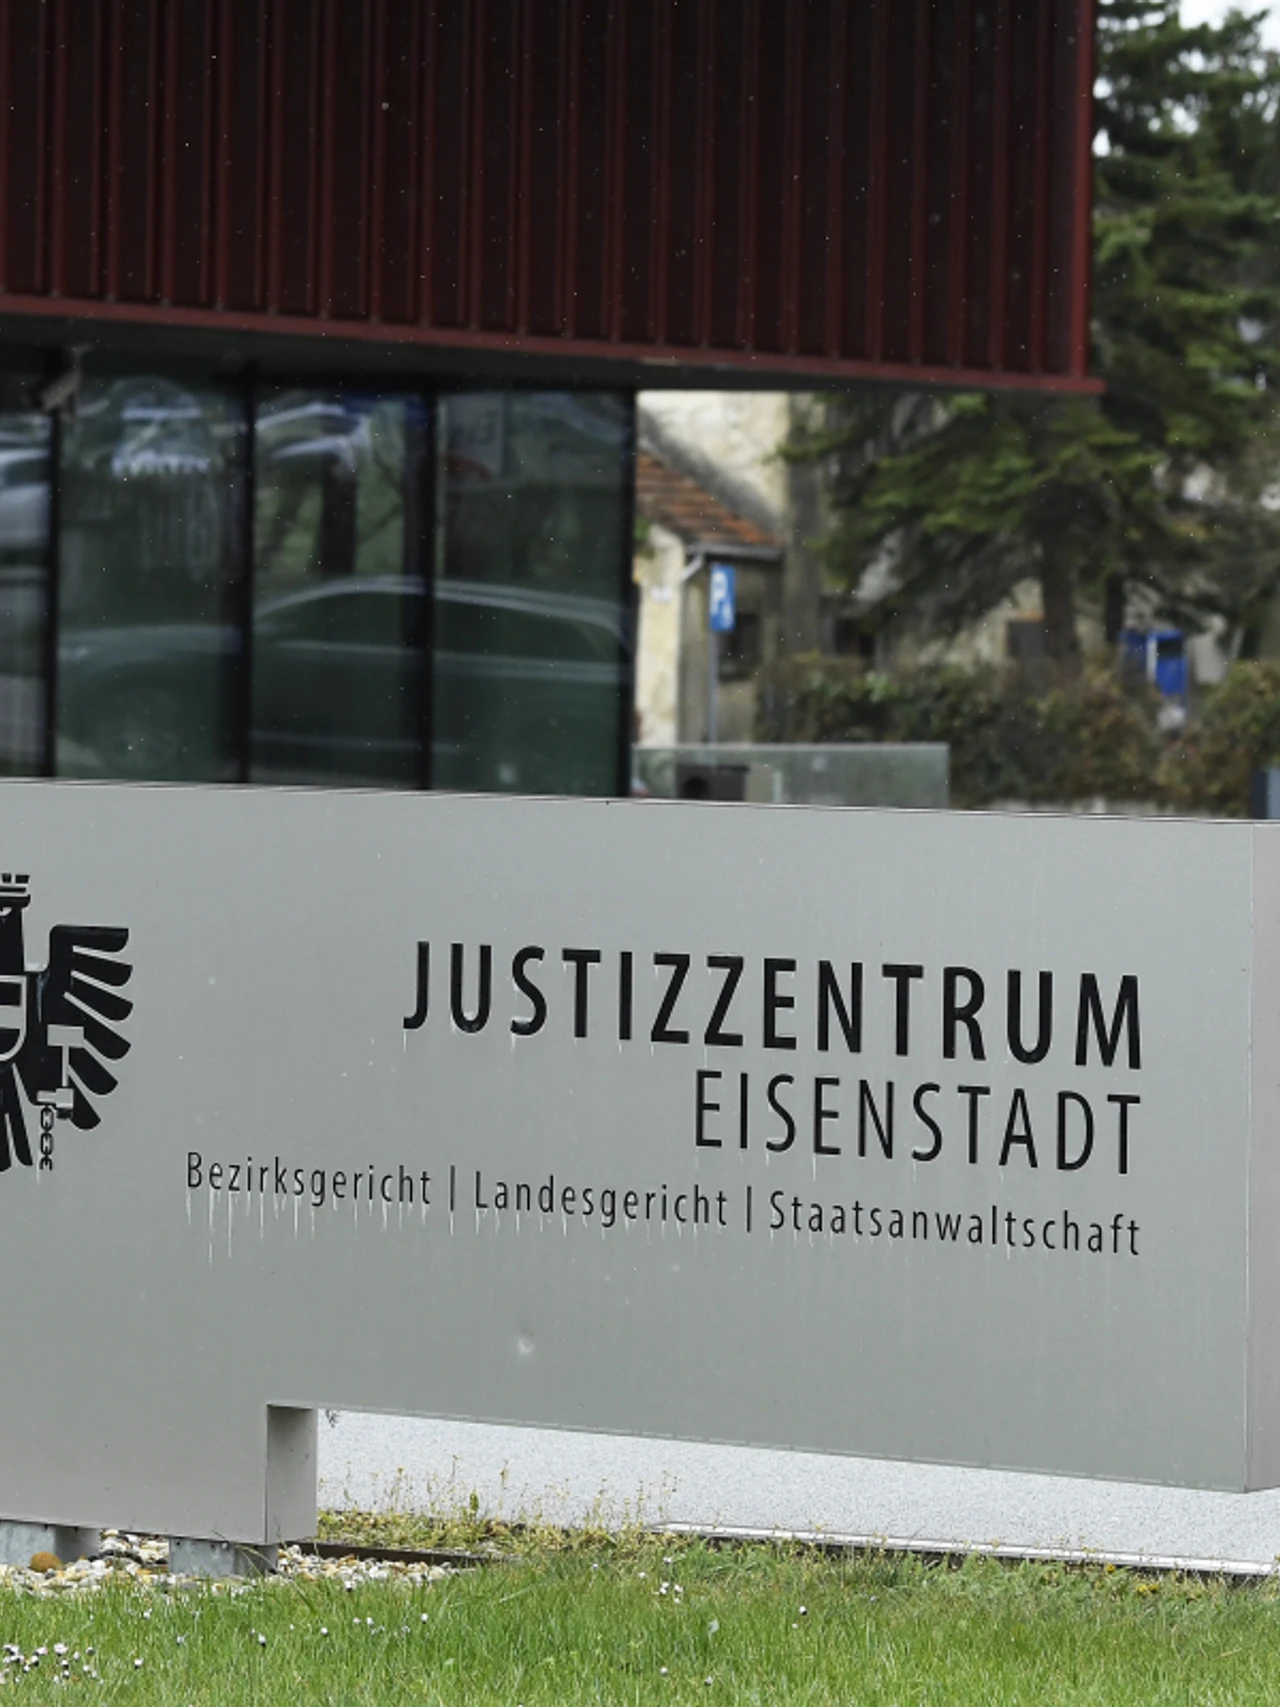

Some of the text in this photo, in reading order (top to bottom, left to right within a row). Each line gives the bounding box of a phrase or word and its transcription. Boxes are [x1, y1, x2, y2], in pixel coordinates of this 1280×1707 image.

[403, 941, 1141, 1070] JUSTIZZENTRUM
[695, 1069, 1141, 1175] EISENSTADT
[187, 1151, 431, 1207] Bezirksgericht
[475, 1170, 727, 1228] Landesgericht
[770, 1190, 1140, 1256] Staatsanwaltschaft
